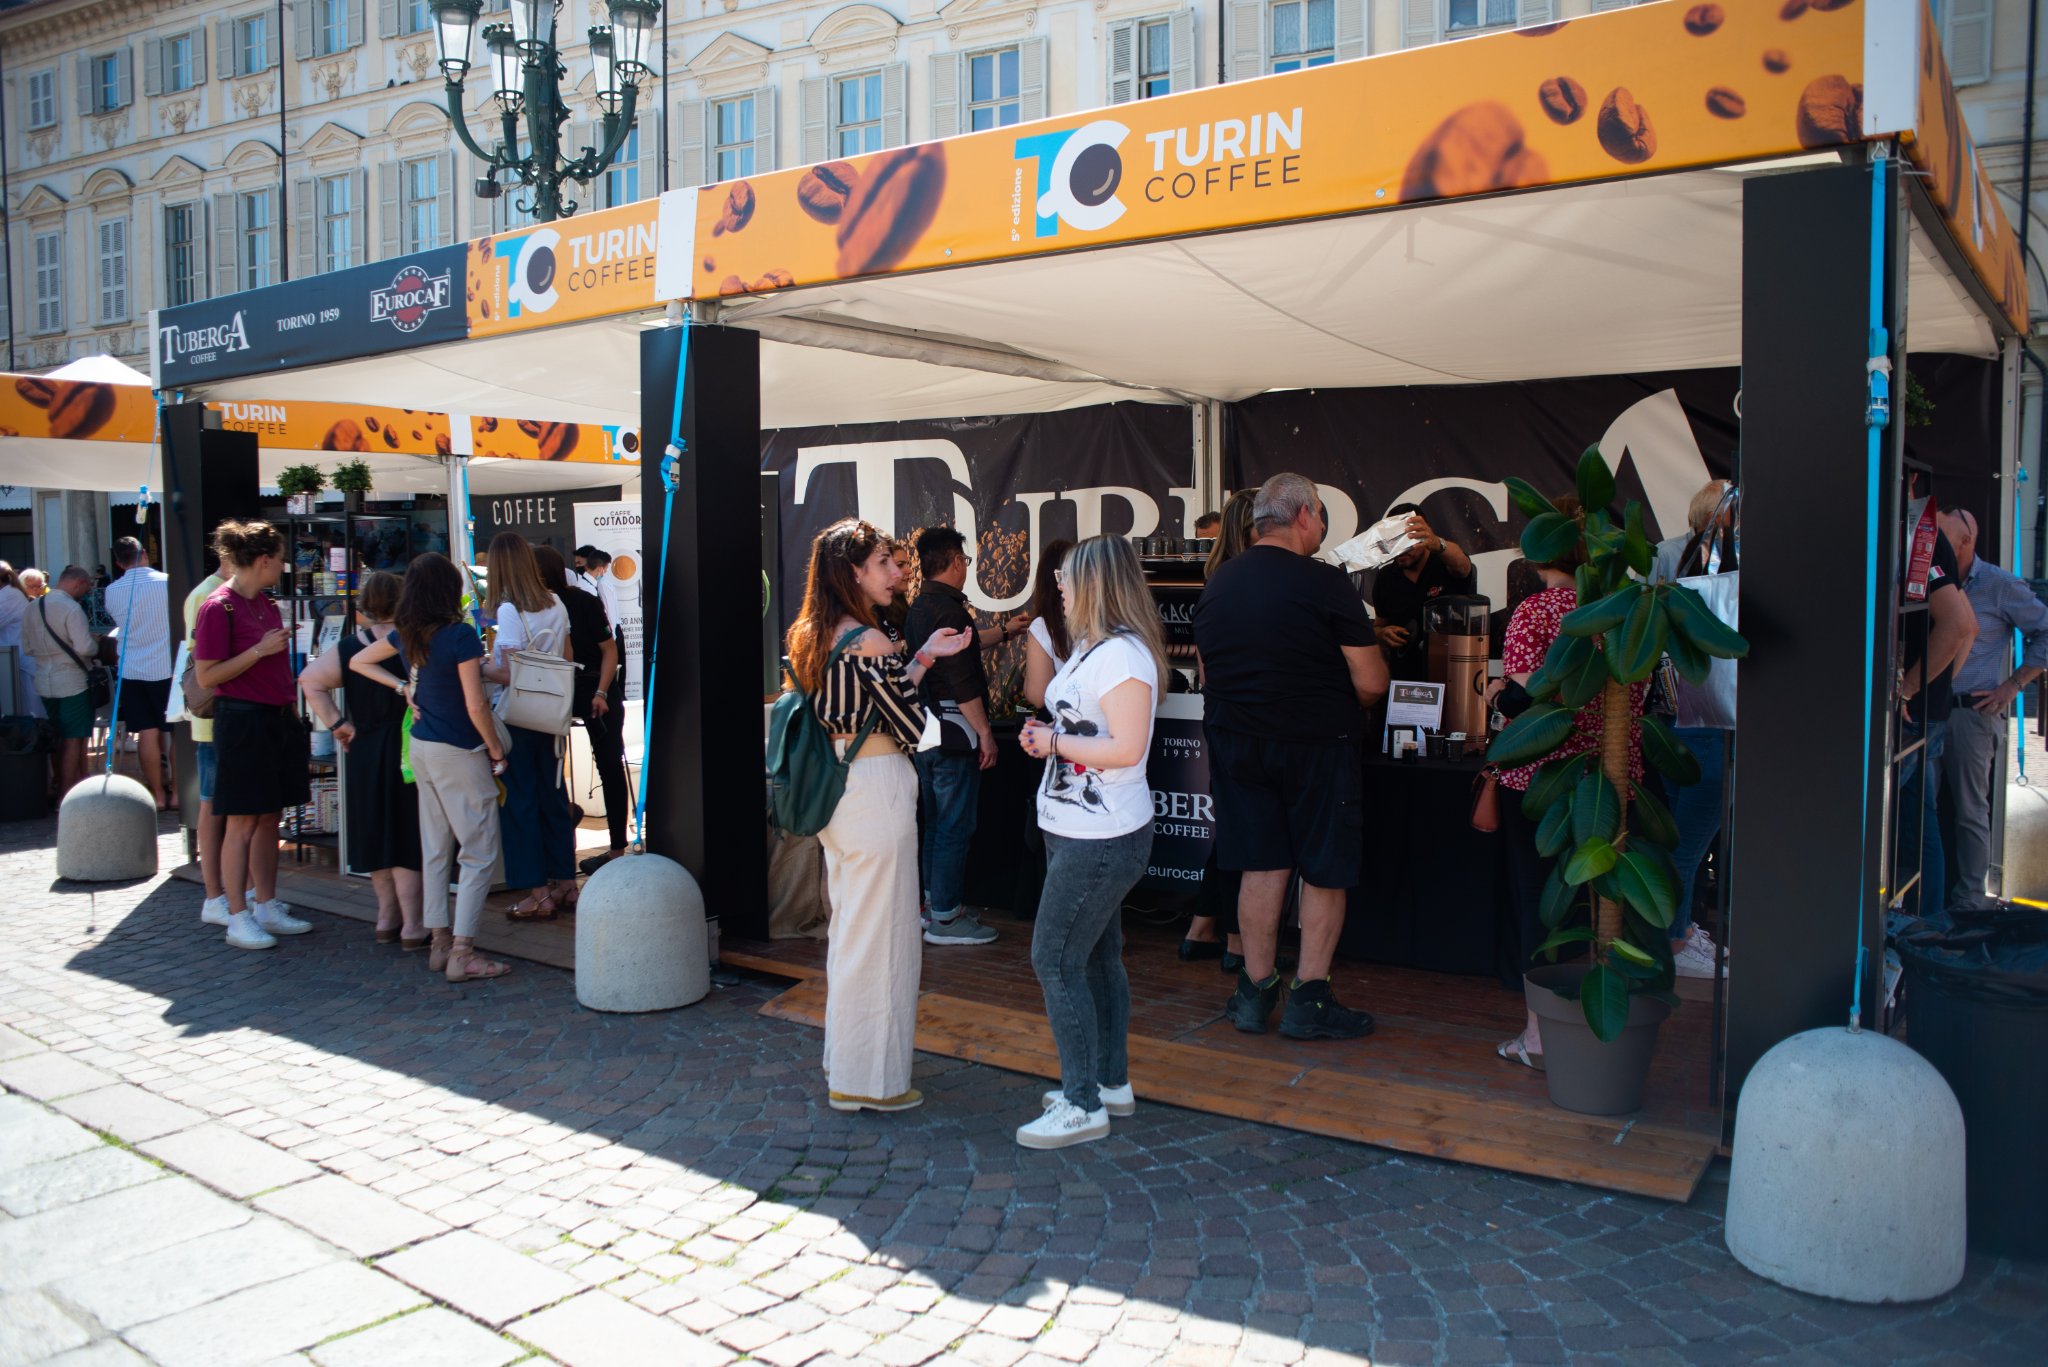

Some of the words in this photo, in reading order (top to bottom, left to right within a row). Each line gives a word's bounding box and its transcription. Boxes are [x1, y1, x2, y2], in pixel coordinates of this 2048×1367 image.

[1145, 107, 1303, 172] TURIN
[1145, 155, 1300, 203] COFFEE
[1011, 168, 1023, 225] edizione
[569, 221, 657, 268] TURIN
[569, 256, 655, 292] COFFEE
[372, 278, 449, 319] EUROCAF
[277, 313, 315, 332] TORINO
[320, 308, 340, 323] 1959
[160, 310, 250, 365] TUBERGA
[190, 351, 217, 365] COFFEE
[219, 402, 287, 423] TURIN
[492, 497, 557, 526] COFFEE
[593, 515, 642, 526] COSTADOR
[629, 616, 643, 625] ANN
[1174, 626, 1190, 635] MIL
[1163, 737, 1201, 748] TORINO
[1153, 822, 1210, 839] COFFEE
